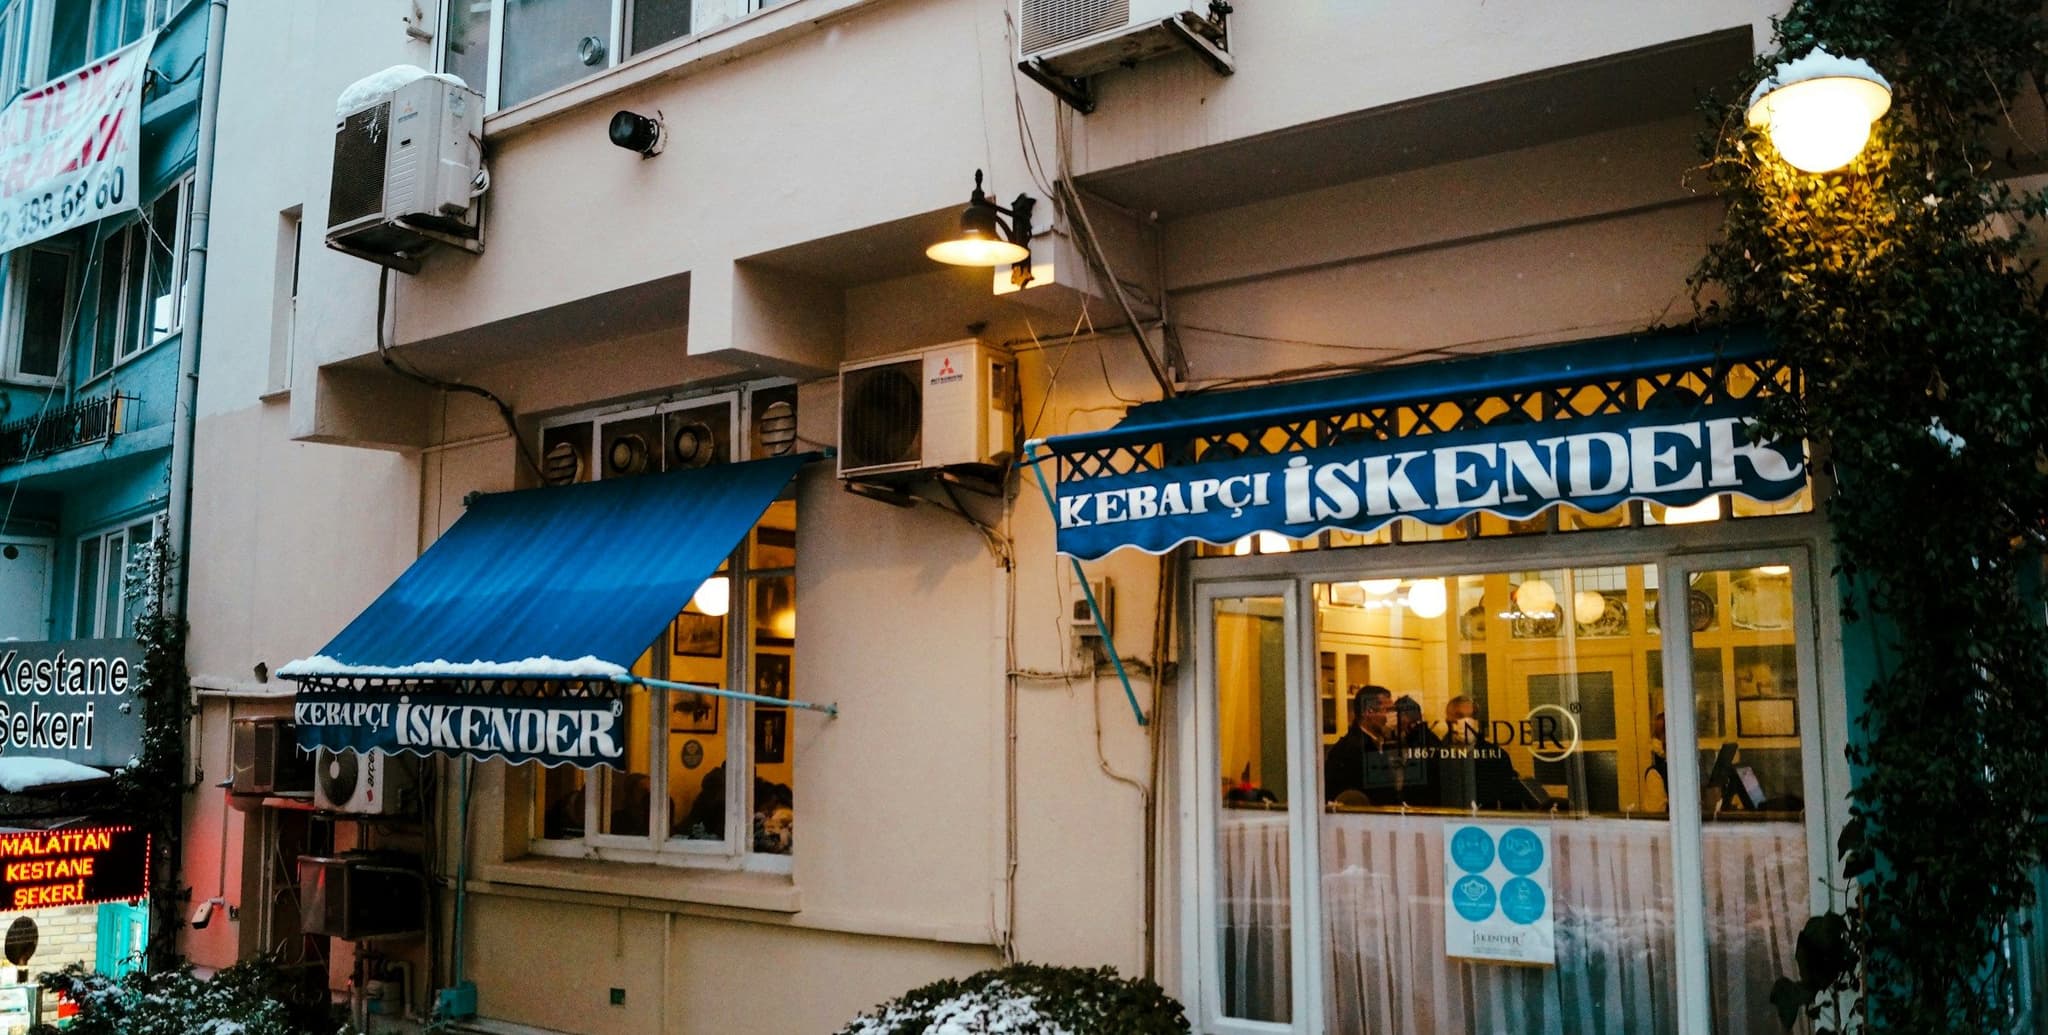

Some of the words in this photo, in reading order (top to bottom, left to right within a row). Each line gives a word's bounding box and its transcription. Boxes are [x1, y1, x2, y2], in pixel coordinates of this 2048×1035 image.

[16, 192, 54, 237] 393
[60, 179, 89, 222] 68
[95, 165, 125, 210] 60
[1058, 472, 1271, 529] KEBAPÇI
[1283, 416, 1803, 525] İSKENDER
[0, 649, 129, 696] Kestane
[294, 701, 391, 733] KEBAPÇI
[0, 832, 110, 857] MALATTAN
[6, 858, 94, 882] KESTANE
[14, 878, 85, 912] ŞEKERİ
